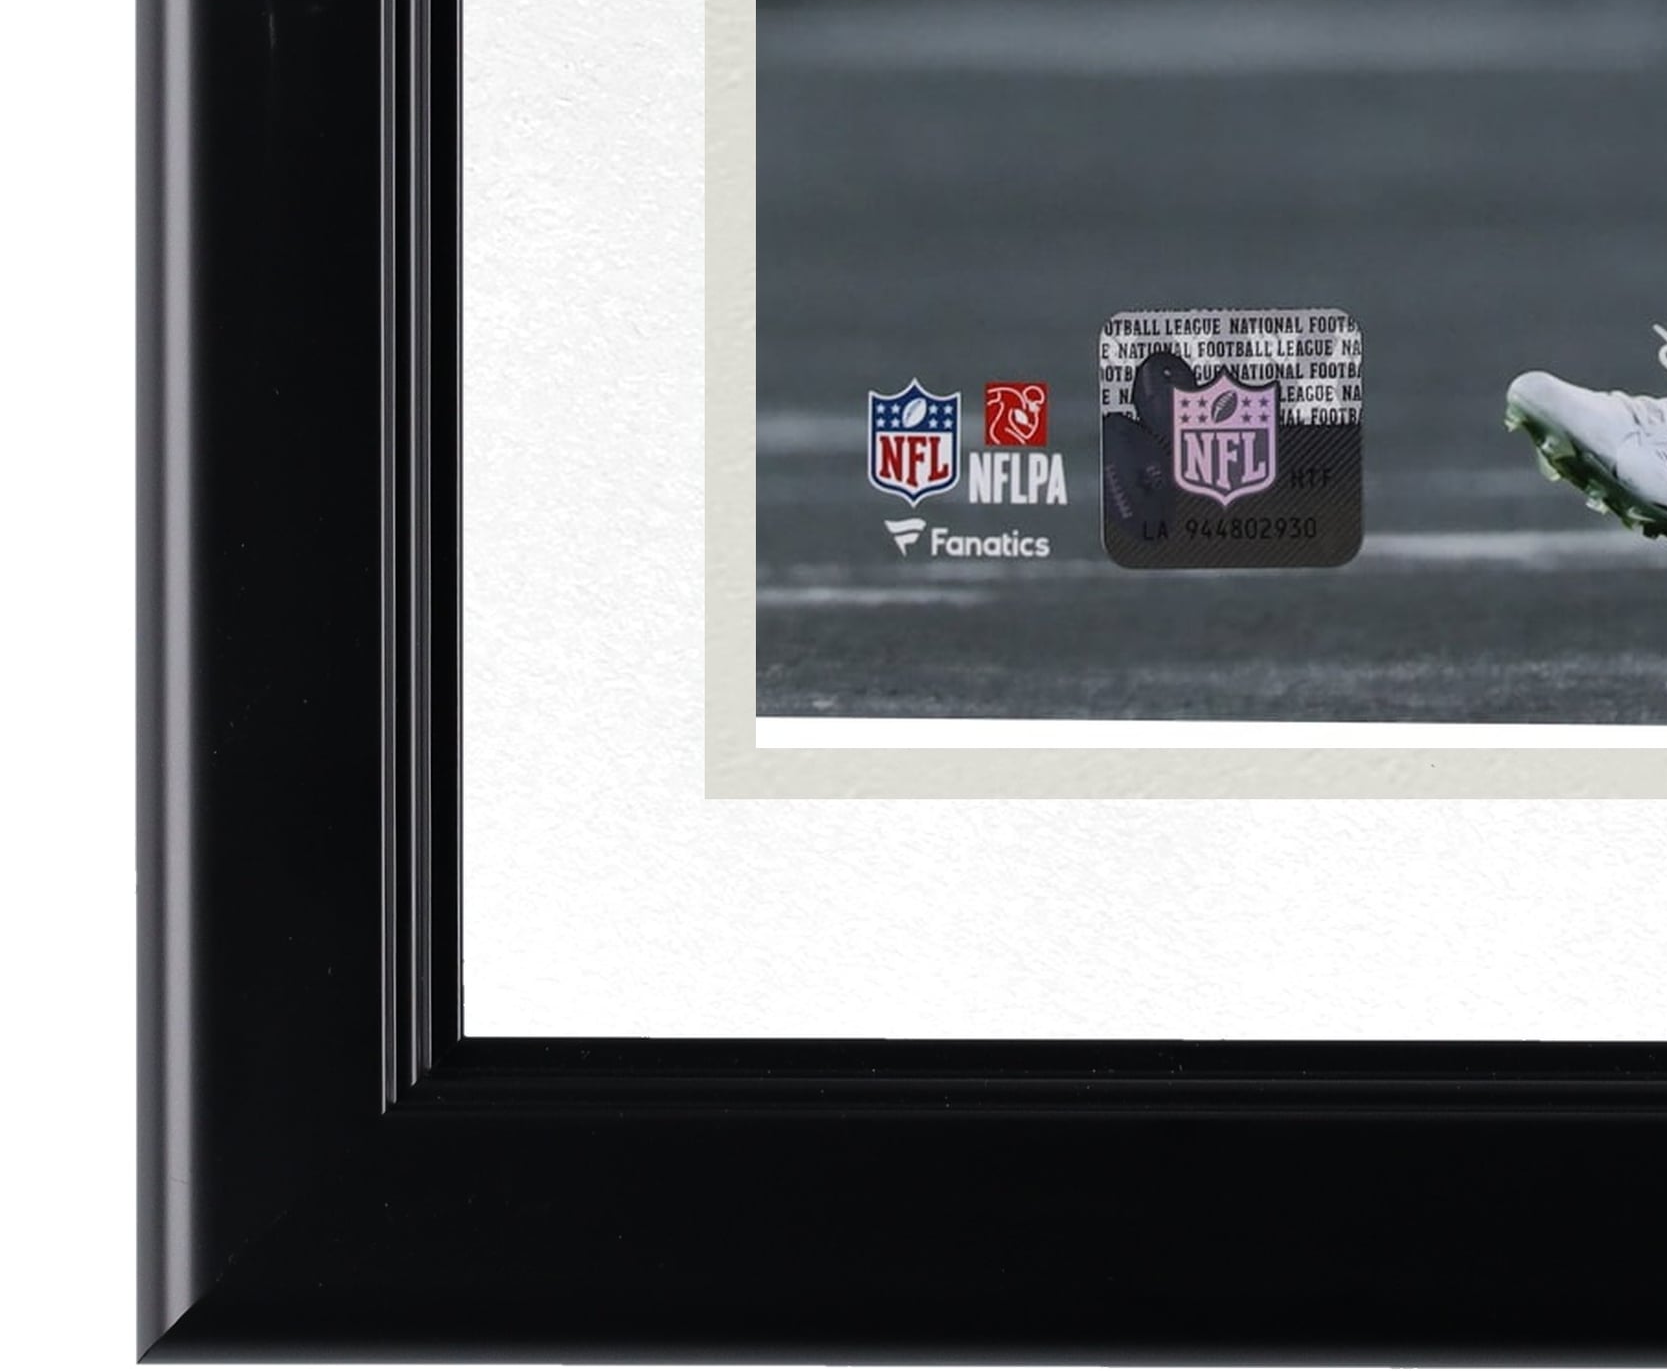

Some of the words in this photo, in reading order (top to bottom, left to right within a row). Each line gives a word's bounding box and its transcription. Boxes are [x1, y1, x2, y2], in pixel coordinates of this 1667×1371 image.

[1165, 318, 1221, 336] LEAGUE
[1229, 317, 1304, 334] NATIONAL
[1308, 316, 1360, 333] FOOTB
[1118, 341, 1191, 359] NATIONAL
[1198, 340, 1273, 358] FOOTBALL
[1277, 339, 1333, 357] LEAGUE
[1229, 362, 1304, 380] NATIONAL
[1280, 385, 1335, 402] LEAGUE
[1311, 408, 1361, 425] FOOTB
[879, 435, 949, 487] NFL
[1184, 432, 1266, 490] NFL
[969, 452, 1068, 505] NFLPA
[1143, 520, 1169, 541] LA
[1185, 517, 1318, 540] 944802930
[930, 527, 1050, 557] Fanatics
